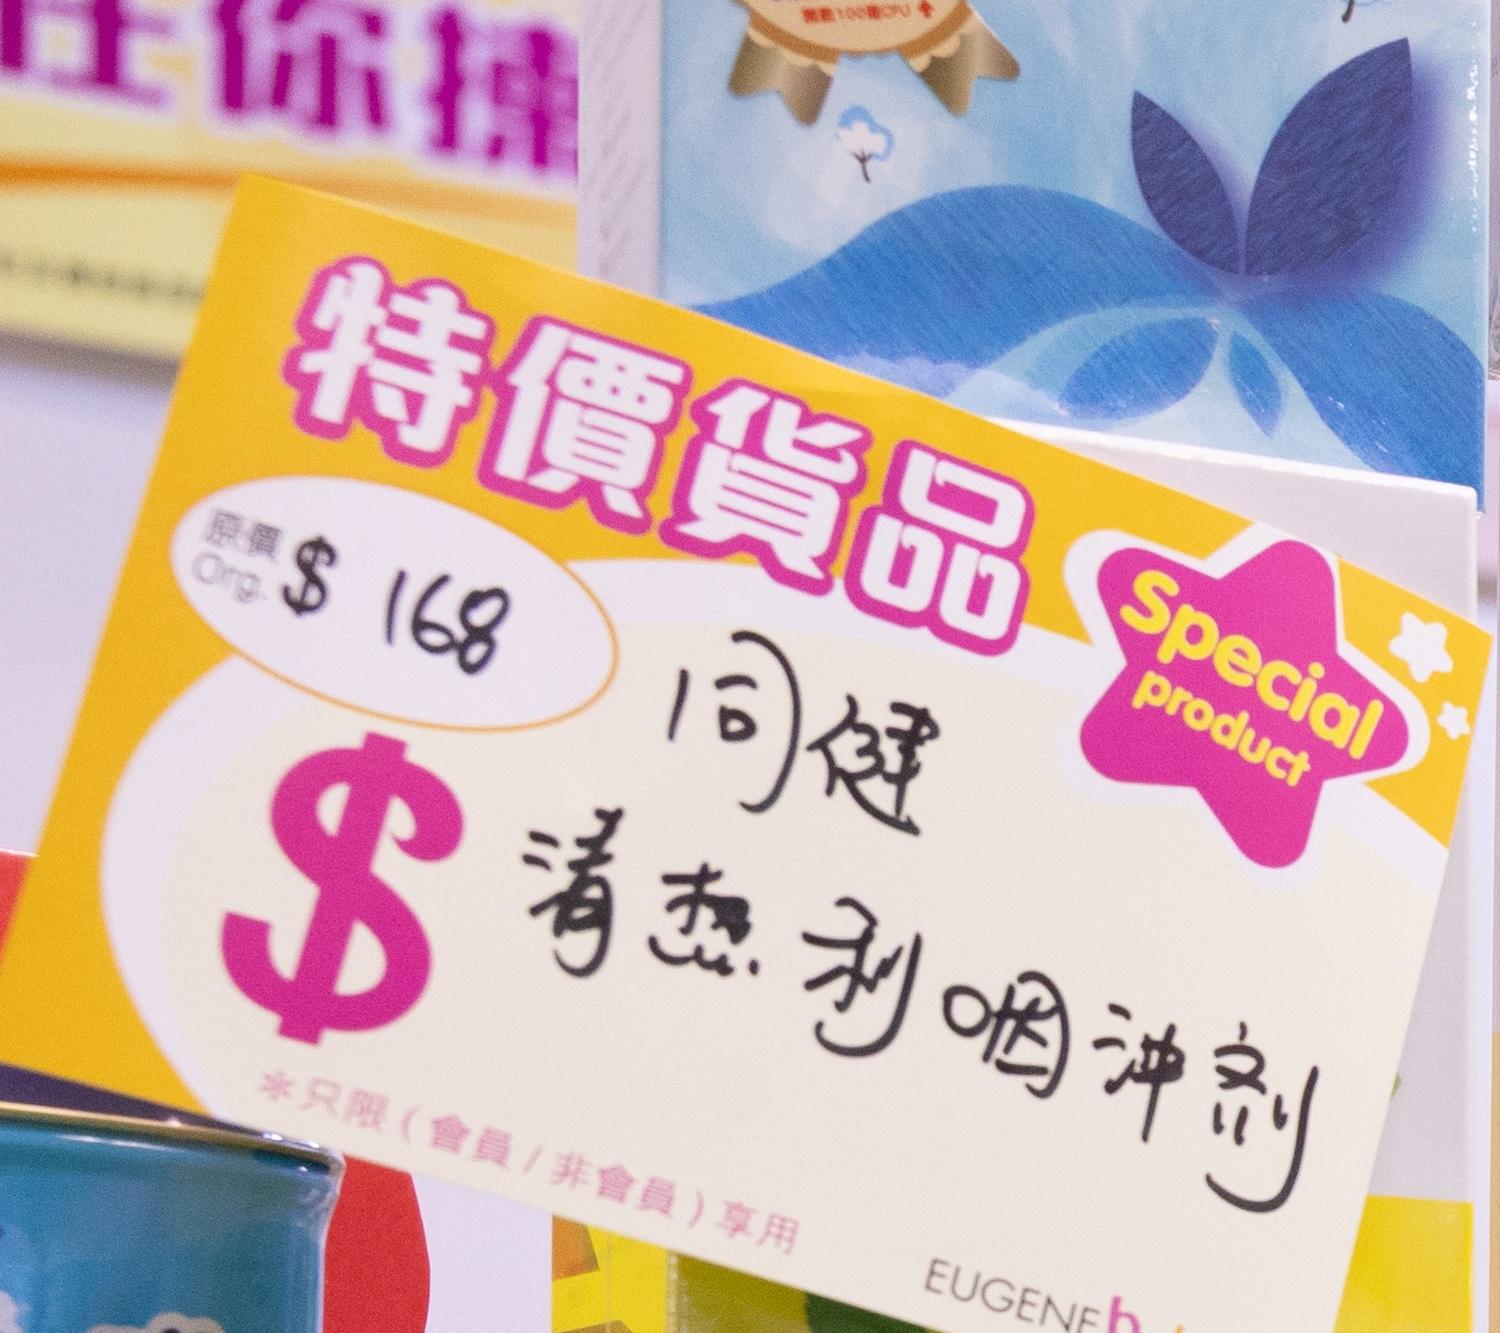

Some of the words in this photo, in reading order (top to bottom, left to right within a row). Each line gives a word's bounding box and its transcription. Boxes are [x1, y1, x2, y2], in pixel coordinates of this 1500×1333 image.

[203, 508, 285, 560] 原價
[278, 252, 1037, 658] 特價貨品
[193, 548, 268, 606] Org.
[385, 568, 512, 675] 168
[1118, 568, 1385, 762] Special
